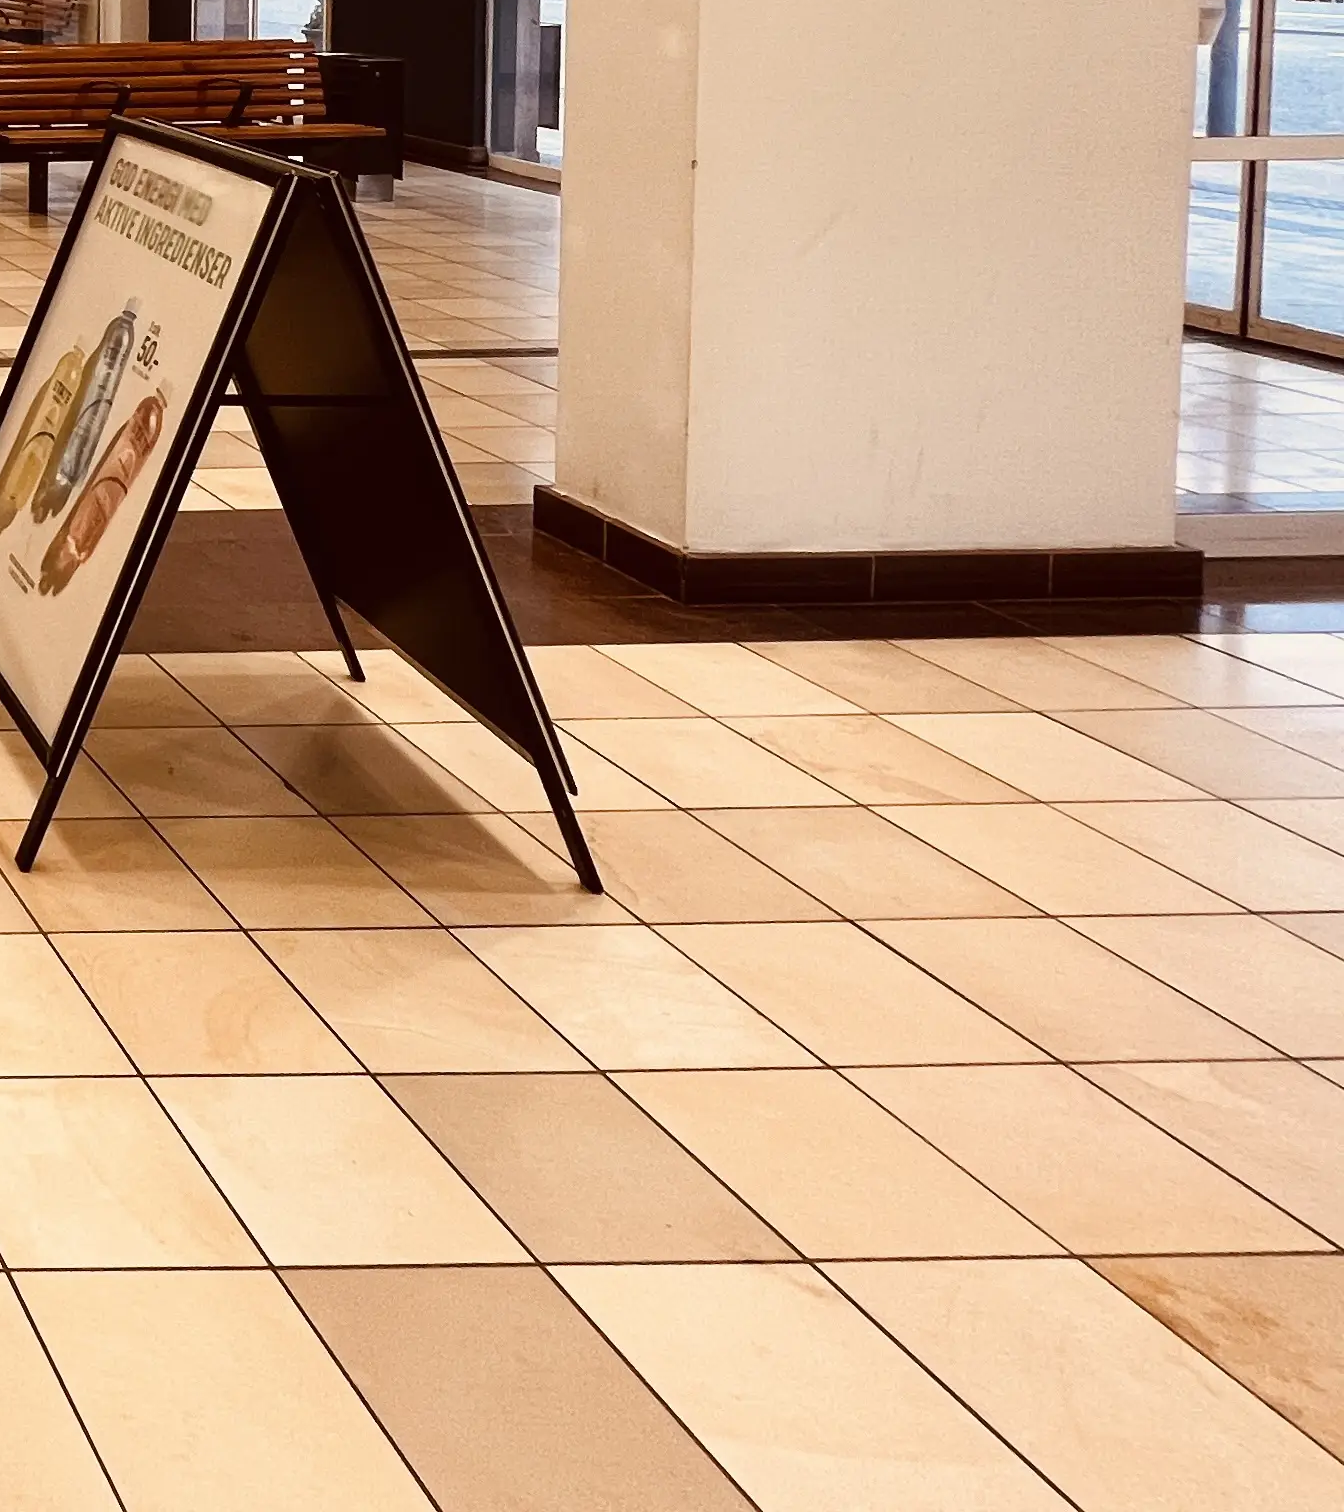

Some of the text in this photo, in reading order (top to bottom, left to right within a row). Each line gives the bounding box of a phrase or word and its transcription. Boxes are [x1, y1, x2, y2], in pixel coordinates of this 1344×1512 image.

[109, 158, 139, 192] GOD
[133, 168, 184, 214] ENERGI
[94, 194, 233, 290] AKTIVE INGREDIENSER
